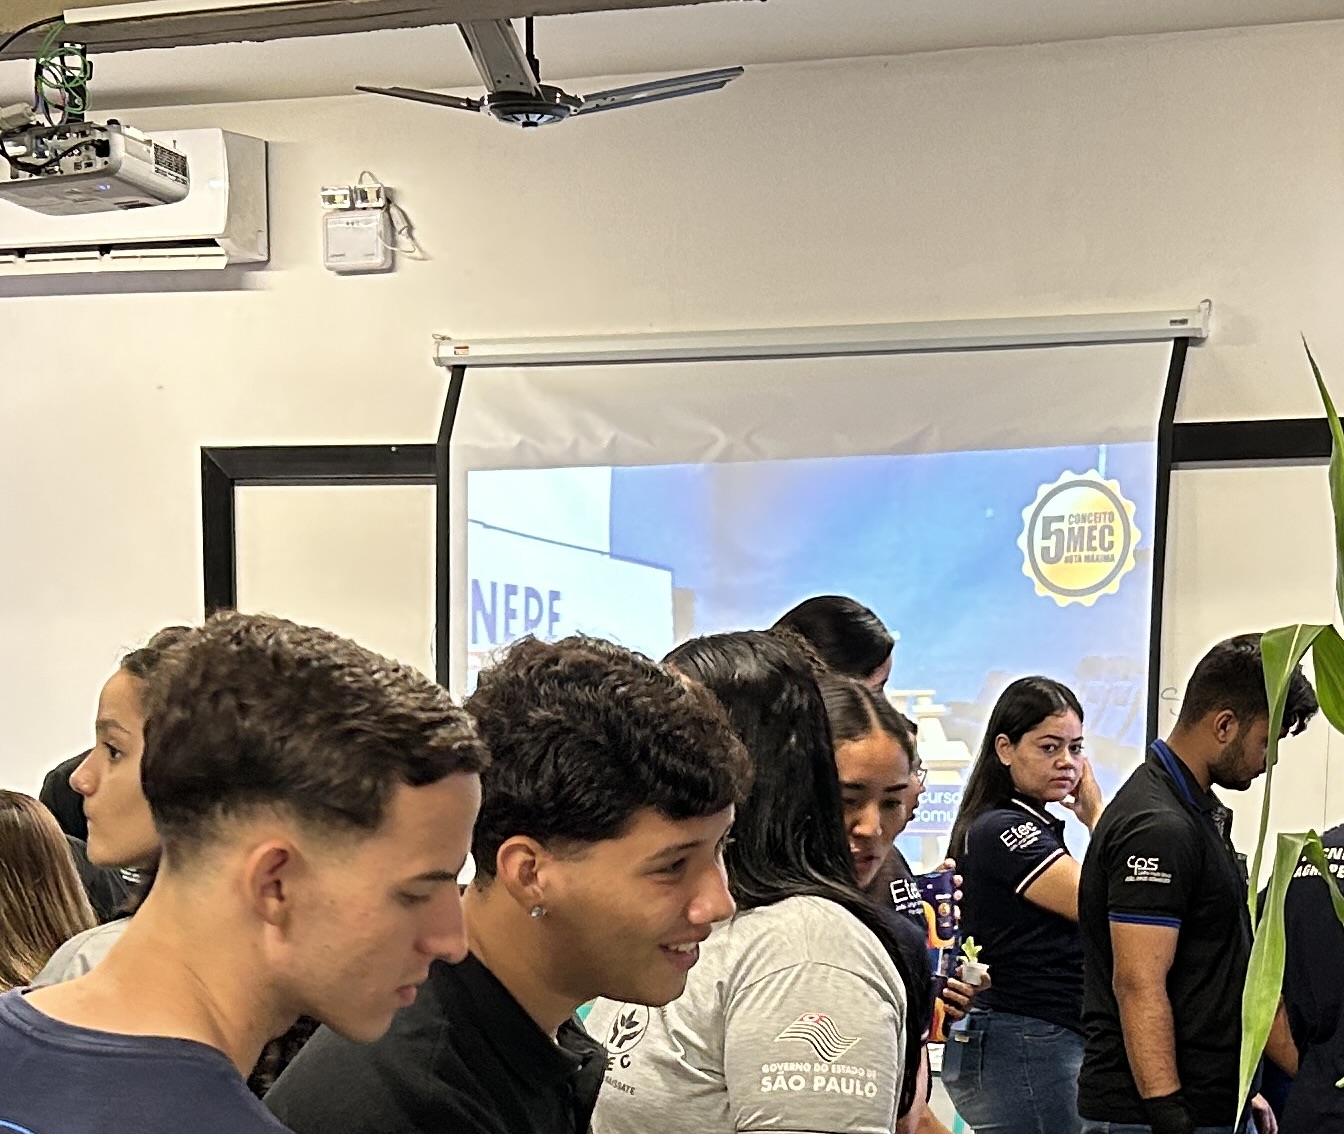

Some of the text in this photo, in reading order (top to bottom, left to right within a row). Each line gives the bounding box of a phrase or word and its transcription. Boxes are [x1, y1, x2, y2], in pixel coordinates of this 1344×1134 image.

[1067, 511, 1115, 525] CONCEITO
[1041, 515, 1065, 565] 5
[1066, 524, 1115, 553] MEC
[999, 821, 1038, 848] Etec
[889, 878, 923, 904] Ete
[761, 1062, 812, 1073] GOVERNO
[814, 1062, 829, 1073] DO
[760, 1070, 878, 1098] SÃO PAULO
